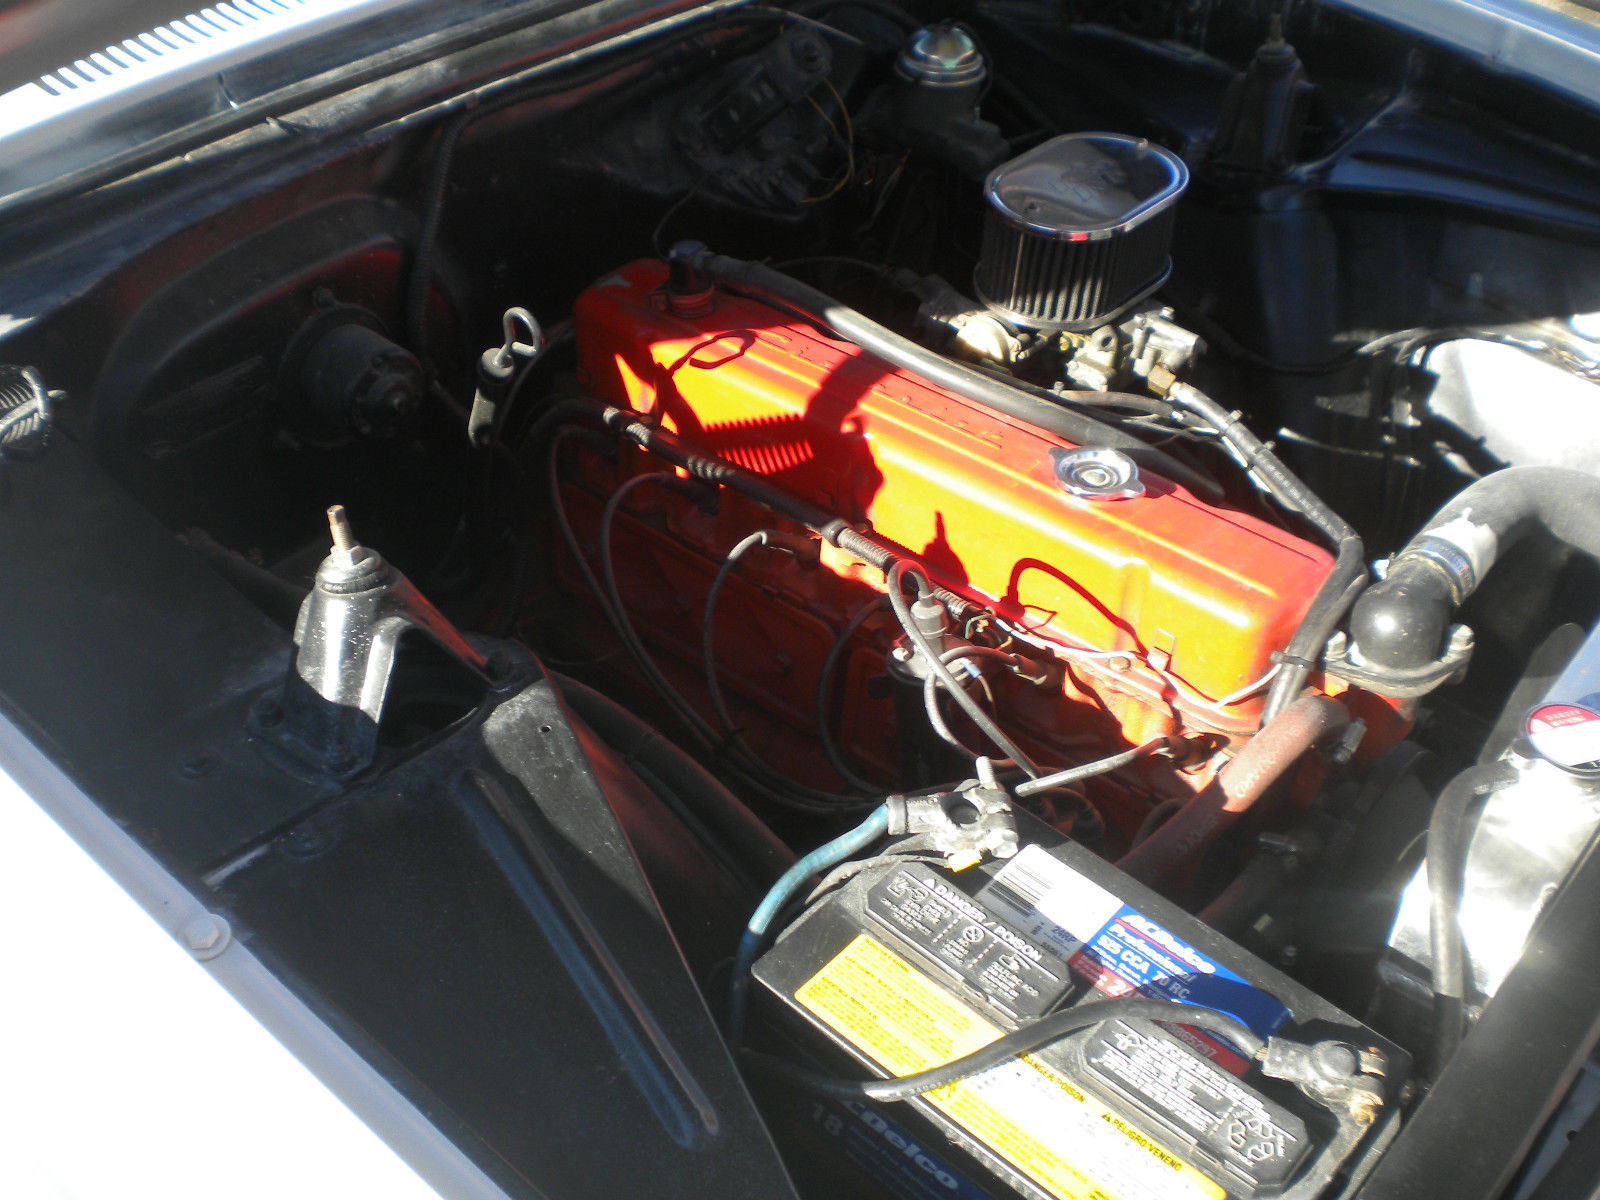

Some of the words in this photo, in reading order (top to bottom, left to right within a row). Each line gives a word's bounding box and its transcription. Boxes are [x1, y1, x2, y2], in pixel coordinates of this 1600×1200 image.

[933, 884, 987, 923] DANGER
[993, 924, 1043, 961] POISON
[1108, 923, 1196, 983] Professional
[1120, 912, 1215, 976] ACDelco
[1118, 949, 1149, 975] CCA
